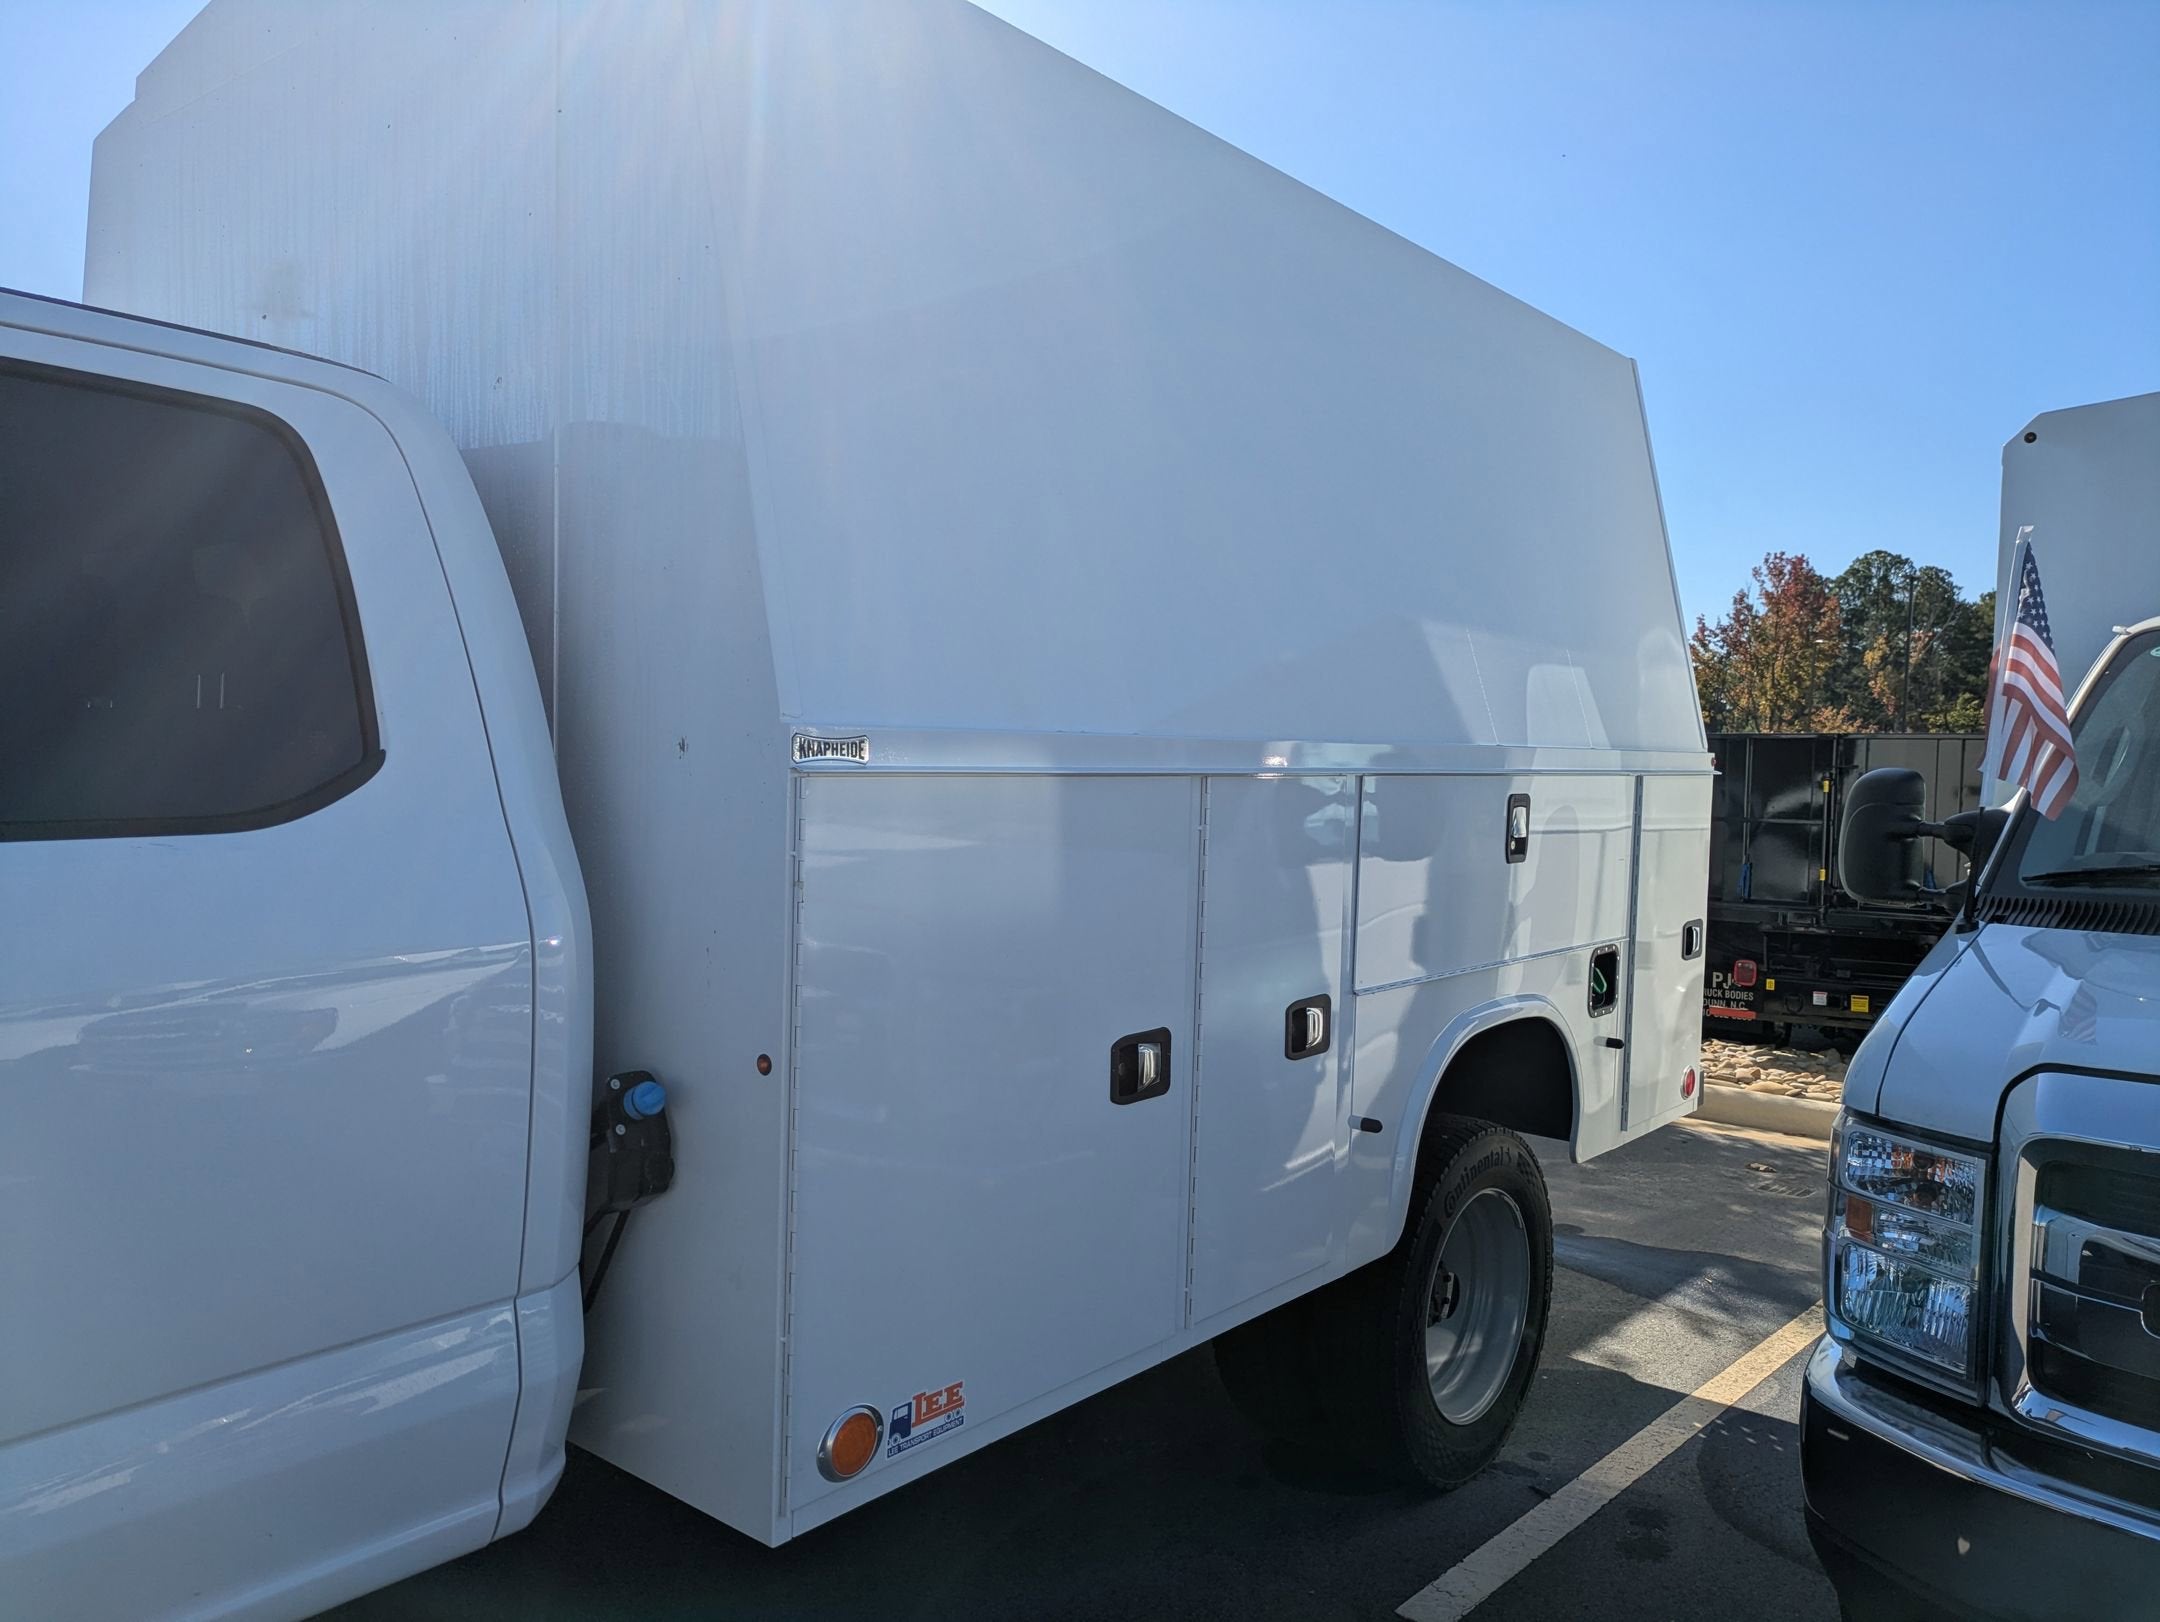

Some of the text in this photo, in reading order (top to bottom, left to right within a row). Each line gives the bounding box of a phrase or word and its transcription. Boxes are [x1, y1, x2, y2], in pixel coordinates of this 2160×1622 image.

[799, 738, 865, 760] KNAPHEIDE
[1724, 990, 1754, 1001] BODIES
[1444, 1146, 1504, 1217] Continental
[911, 1381, 965, 1428] LEE
[888, 1418, 963, 1456] LEE TRANSPORT EQUIPMENT
